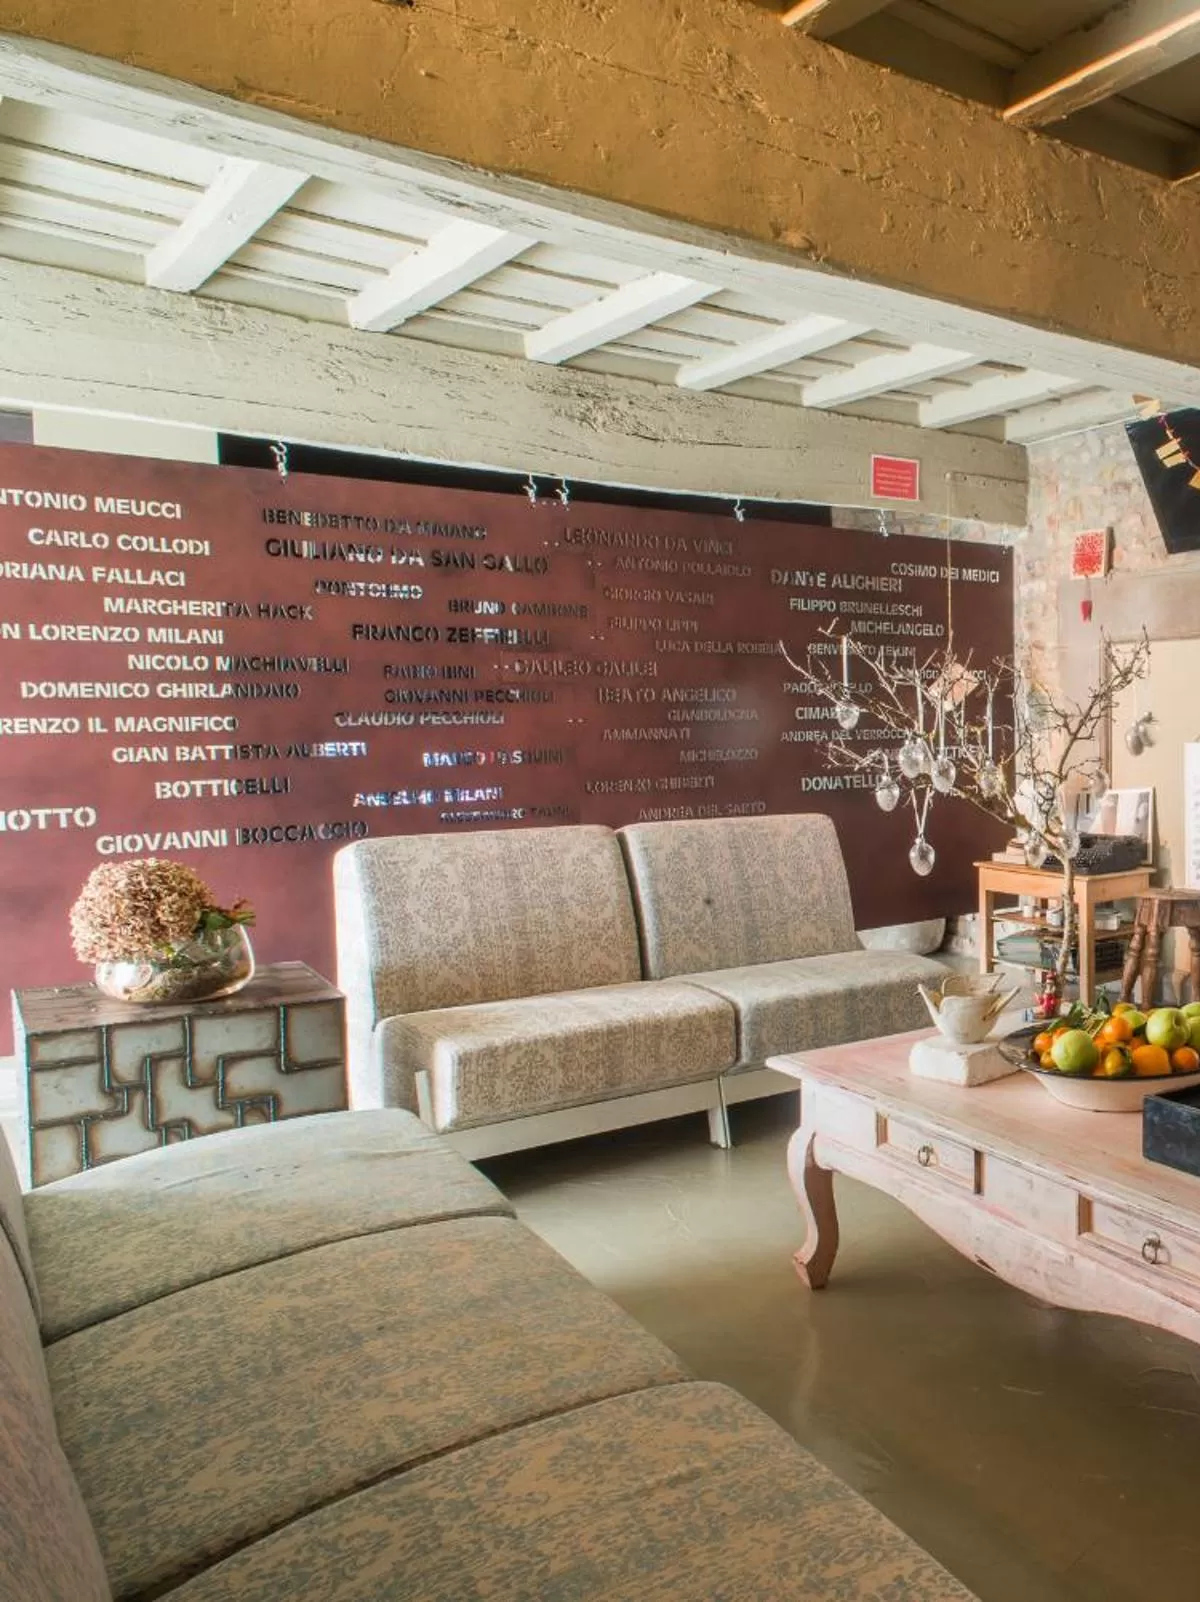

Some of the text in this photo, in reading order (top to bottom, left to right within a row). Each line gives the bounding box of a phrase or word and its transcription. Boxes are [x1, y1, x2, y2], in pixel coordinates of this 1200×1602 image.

[95, 497, 182, 520] MEUCCI
[263, 508, 378, 533] BENEDETTO
[384, 517, 412, 534] DA
[28, 528, 210, 556] CARLO COLLODI
[564, 527, 734, 556] LEONARDO DA VINCI
[265, 538, 549, 575] GIULIANO DA SAN GALLO
[616, 557, 678, 573] ANTONIO
[0, 562, 186, 587] RIANA FALLACI
[771, 568, 902, 594] DANTE ALIGHIERI
[891, 562, 937, 579] COSIMO
[962, 567, 1000, 583] MEDICI
[103, 596, 313, 621] MARGHERITA HACK
[448, 599, 506, 617] BRUNO
[790, 598, 923, 618] FILIPPO BRUNELLESCHI
[0, 623, 224, 645] N LORENZO MILANI
[352, 623, 439, 643] FRANCO
[850, 620, 945, 637] MICHELANGELO
[655, 639, 691, 653] LUCA
[694, 640, 734, 654] DELLA
[128, 654, 349, 675] NICOLO MACHIAVELLI
[515, 659, 658, 678] GALILEO GALILEI
[20, 681, 302, 699] DOMENICO GHIRLANDAIO
[384, 688, 468, 704] GIOVANNI
[599, 687, 737, 704] BEATO ANGELICO
[88, 717, 108, 734] IL
[115, 716, 239, 733] MAGNIFICO
[334, 711, 504, 728] CLAUDIO PECCHIOLI
[781, 729, 828, 742] ANDREA
[831, 729, 852, 742] DEL
[112, 741, 368, 763] GIAN BATTISTA ALBERTI
[155, 776, 291, 799] BOTTICELLI
[639, 801, 766, 821] ANDREA DEL SARTO
[96, 820, 369, 855] GIOVANNI BOCCACCIO
